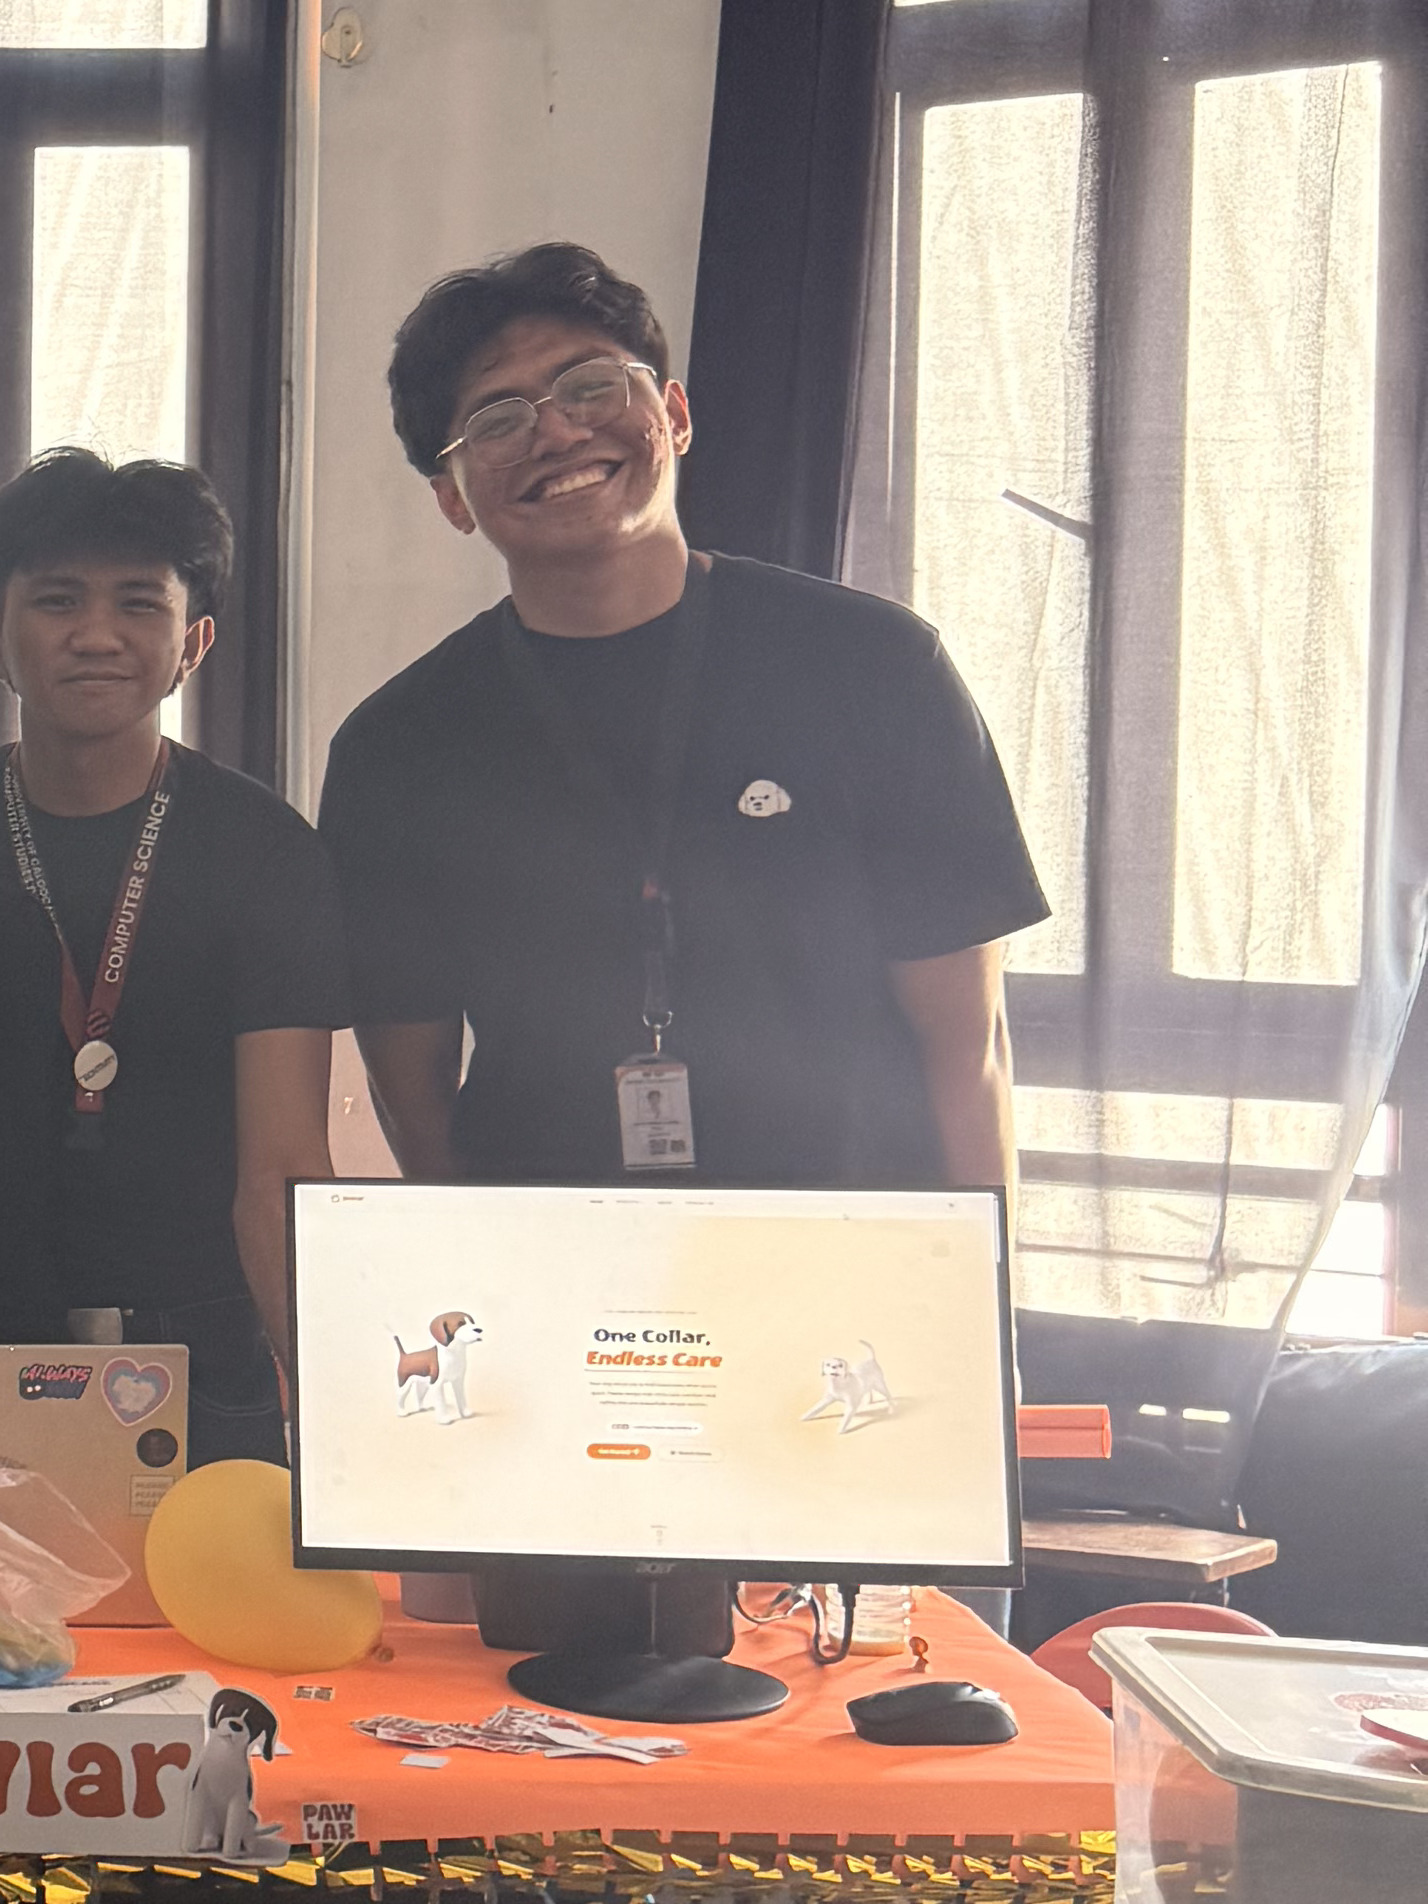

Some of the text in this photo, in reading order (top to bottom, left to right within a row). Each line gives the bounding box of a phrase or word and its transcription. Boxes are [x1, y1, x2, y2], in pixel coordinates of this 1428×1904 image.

[104, 790, 170, 983] COMPUTER SCIENCE
[593, 1328, 711, 1346] One Collar,
[586, 1350, 723, 1368] Endless Care
[302, 1803, 355, 1822] PAW
[306, 1823, 356, 1841] LAR
